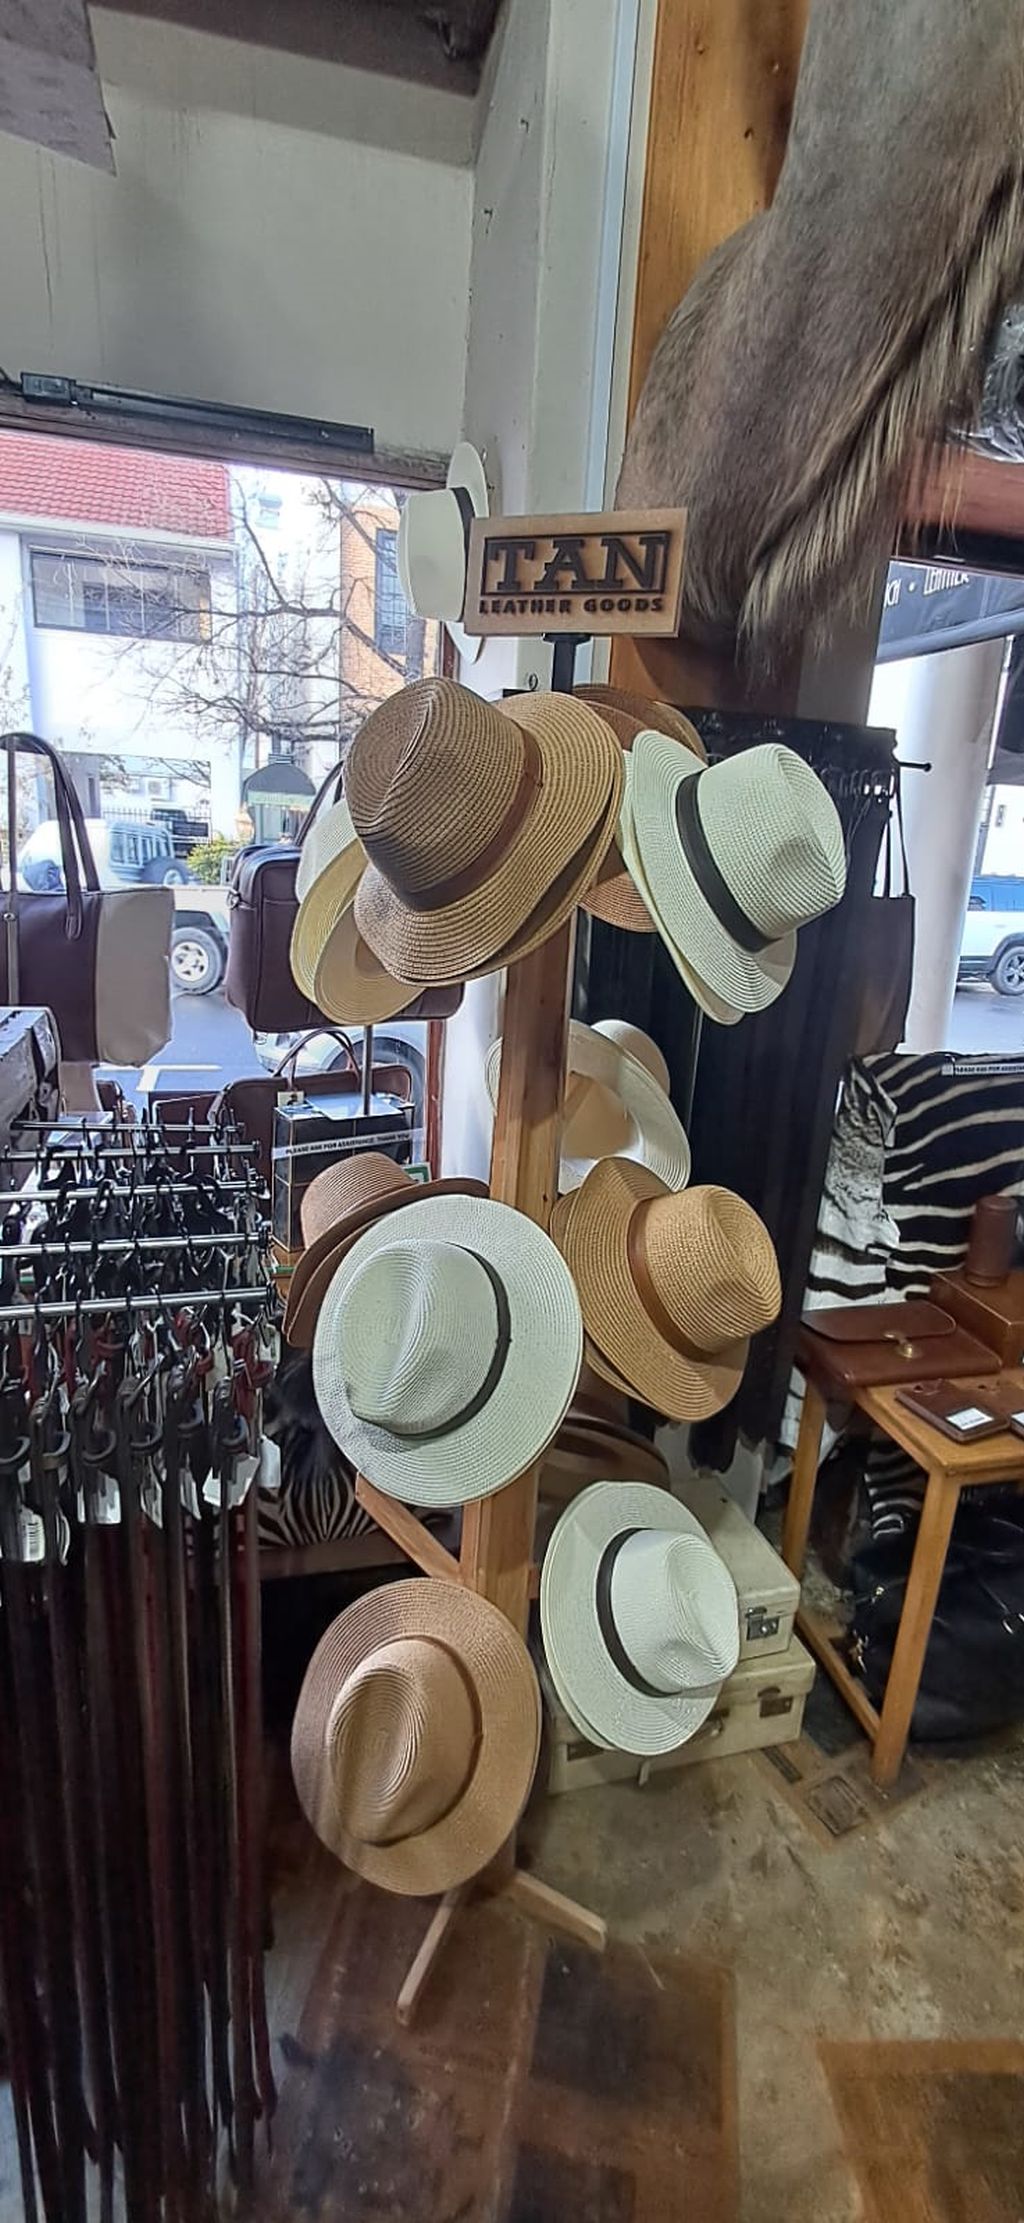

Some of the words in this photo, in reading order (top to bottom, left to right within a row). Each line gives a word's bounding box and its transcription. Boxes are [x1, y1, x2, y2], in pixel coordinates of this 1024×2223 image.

[486, 537, 668, 592] TAN
[479, 598, 571, 615] LEATHER
[583, 597, 664, 613] GOODS
[285, 1144, 309, 1155] PLEASE
[323, 1141, 337, 1149] FOR
